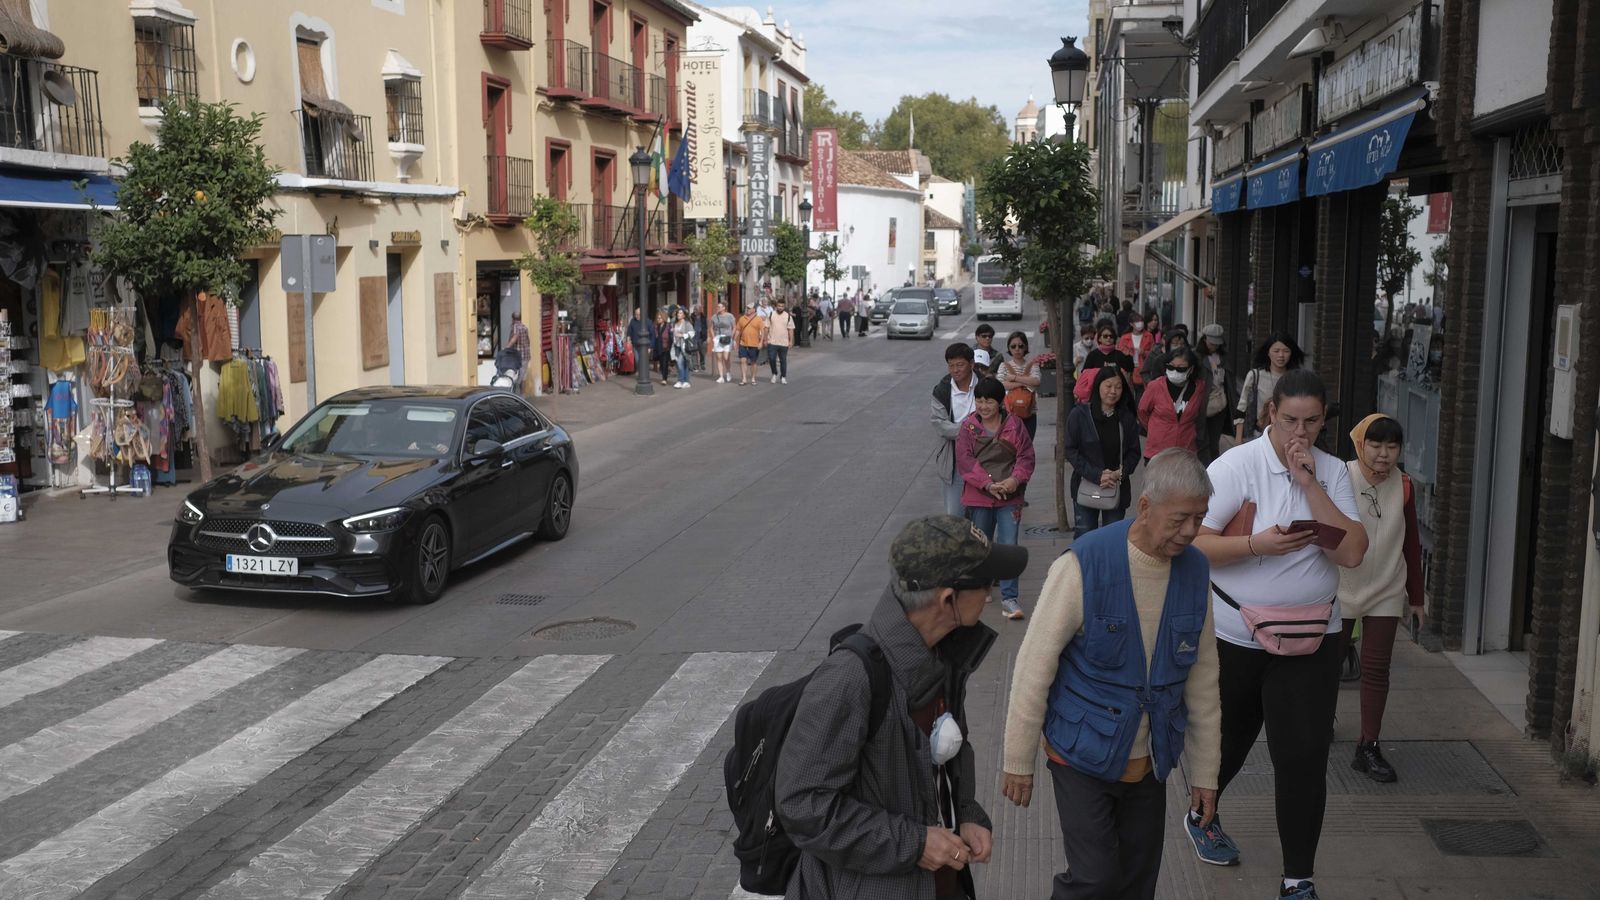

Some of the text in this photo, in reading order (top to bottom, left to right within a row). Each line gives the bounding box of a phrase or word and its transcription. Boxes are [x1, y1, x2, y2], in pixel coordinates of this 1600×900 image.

[683, 61, 718, 70] HOTEL
[684, 80, 698, 185] Restaurante
[700, 92, 721, 174] Don Javier
[751, 134, 765, 236] RESTAURANTE
[741, 238, 775, 253] FLORES
[236, 558, 294, 573] 1321 LZY
